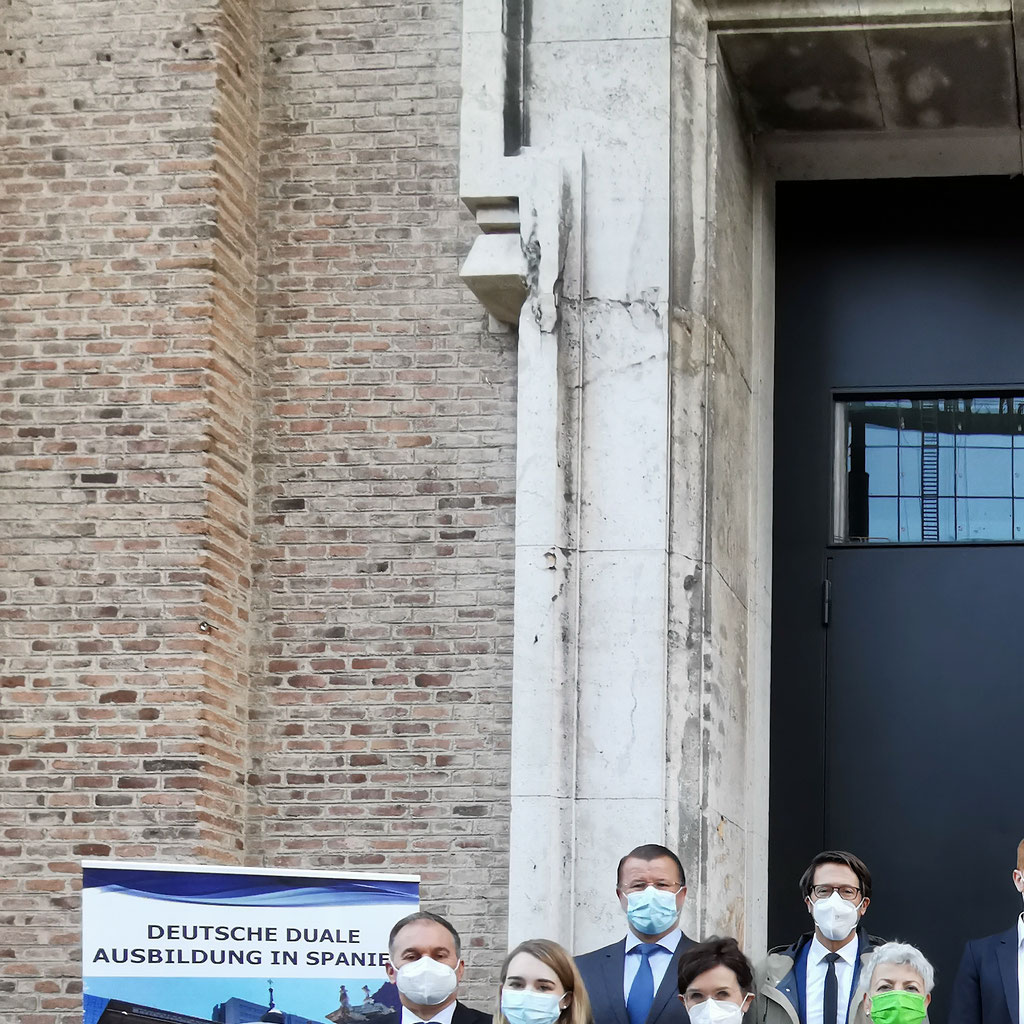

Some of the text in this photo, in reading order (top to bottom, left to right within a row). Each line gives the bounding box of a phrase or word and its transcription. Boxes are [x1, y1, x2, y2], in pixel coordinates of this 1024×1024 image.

[147, 924, 360, 944] DEUTSCHE DUALE
[92, 947, 263, 965] AUSBILDUNG
[270, 950, 298, 966] IN
